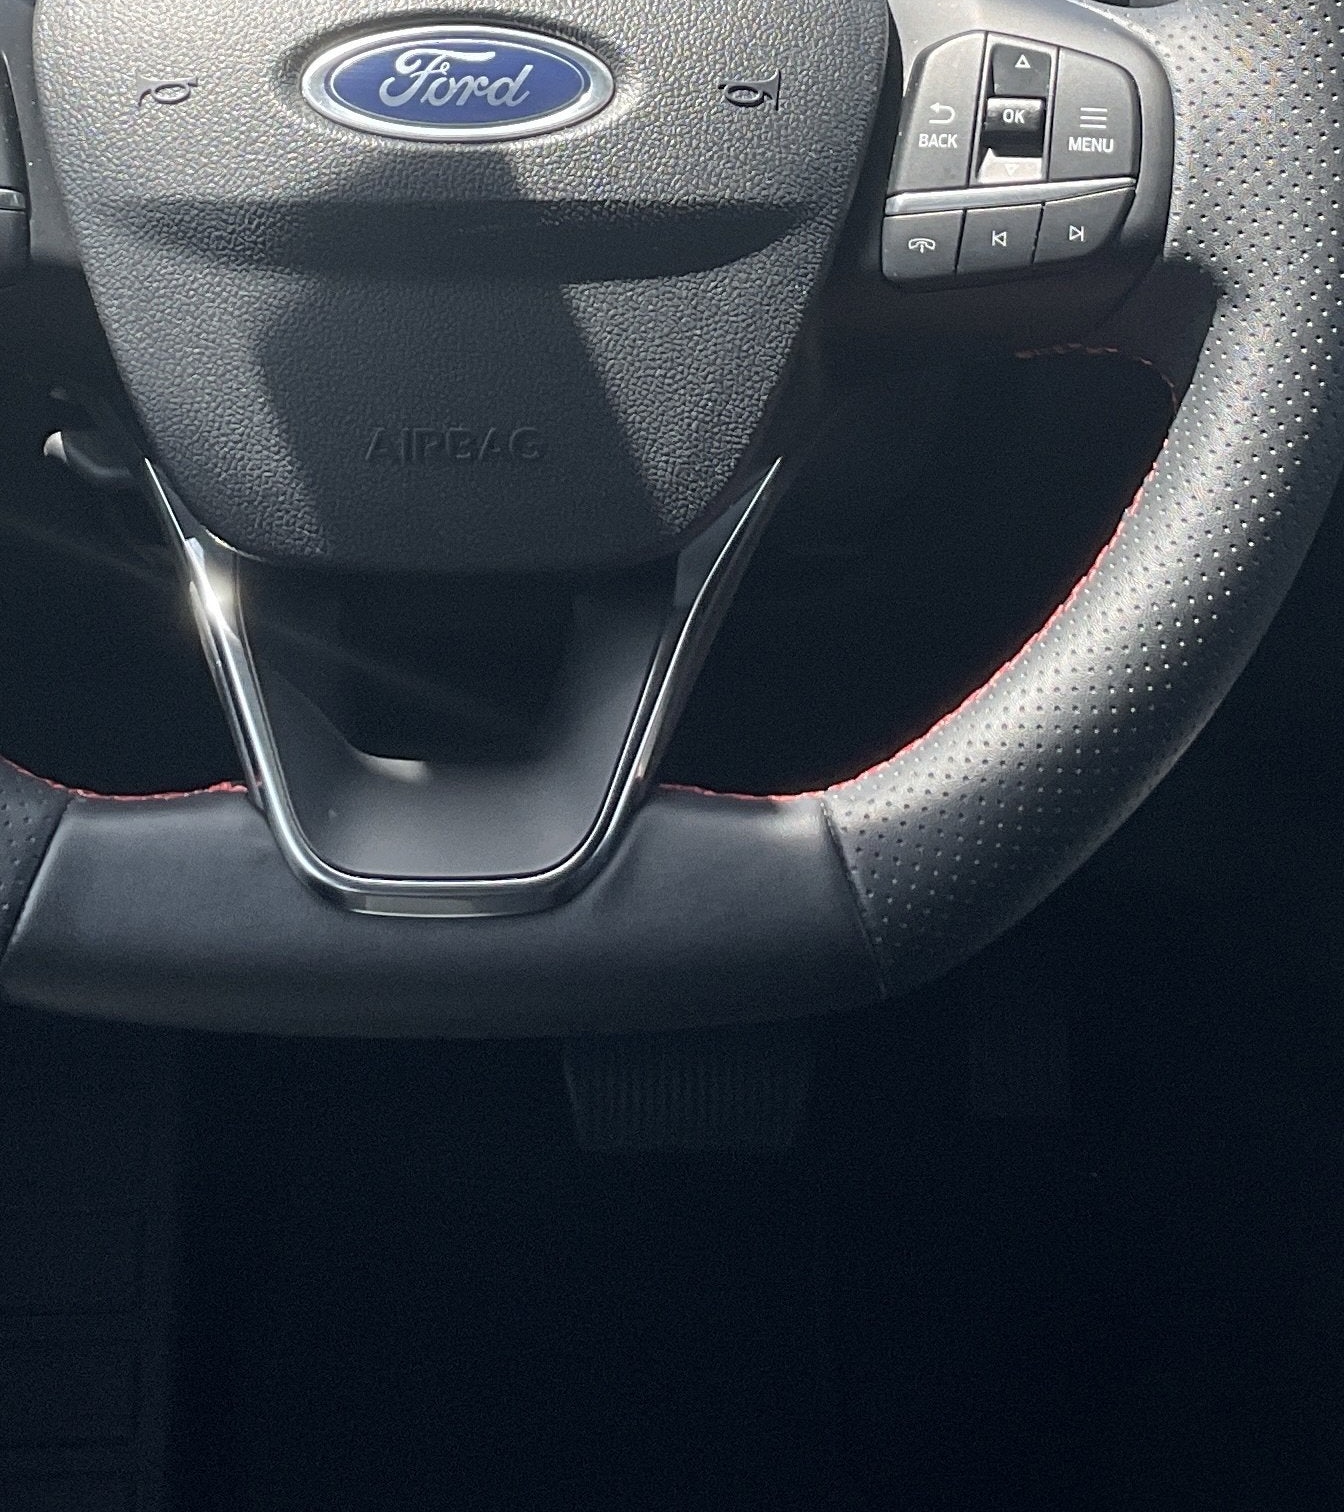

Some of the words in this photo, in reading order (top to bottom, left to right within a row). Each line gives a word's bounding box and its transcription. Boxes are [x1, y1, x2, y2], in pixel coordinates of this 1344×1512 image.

[379, 48, 531, 107] Ford
[1002, 109, 1024, 124] OK
[918, 134, 957, 148] BACK
[1068, 137, 1113, 153] MENU
[364, 427, 546, 462] AIRBAG
